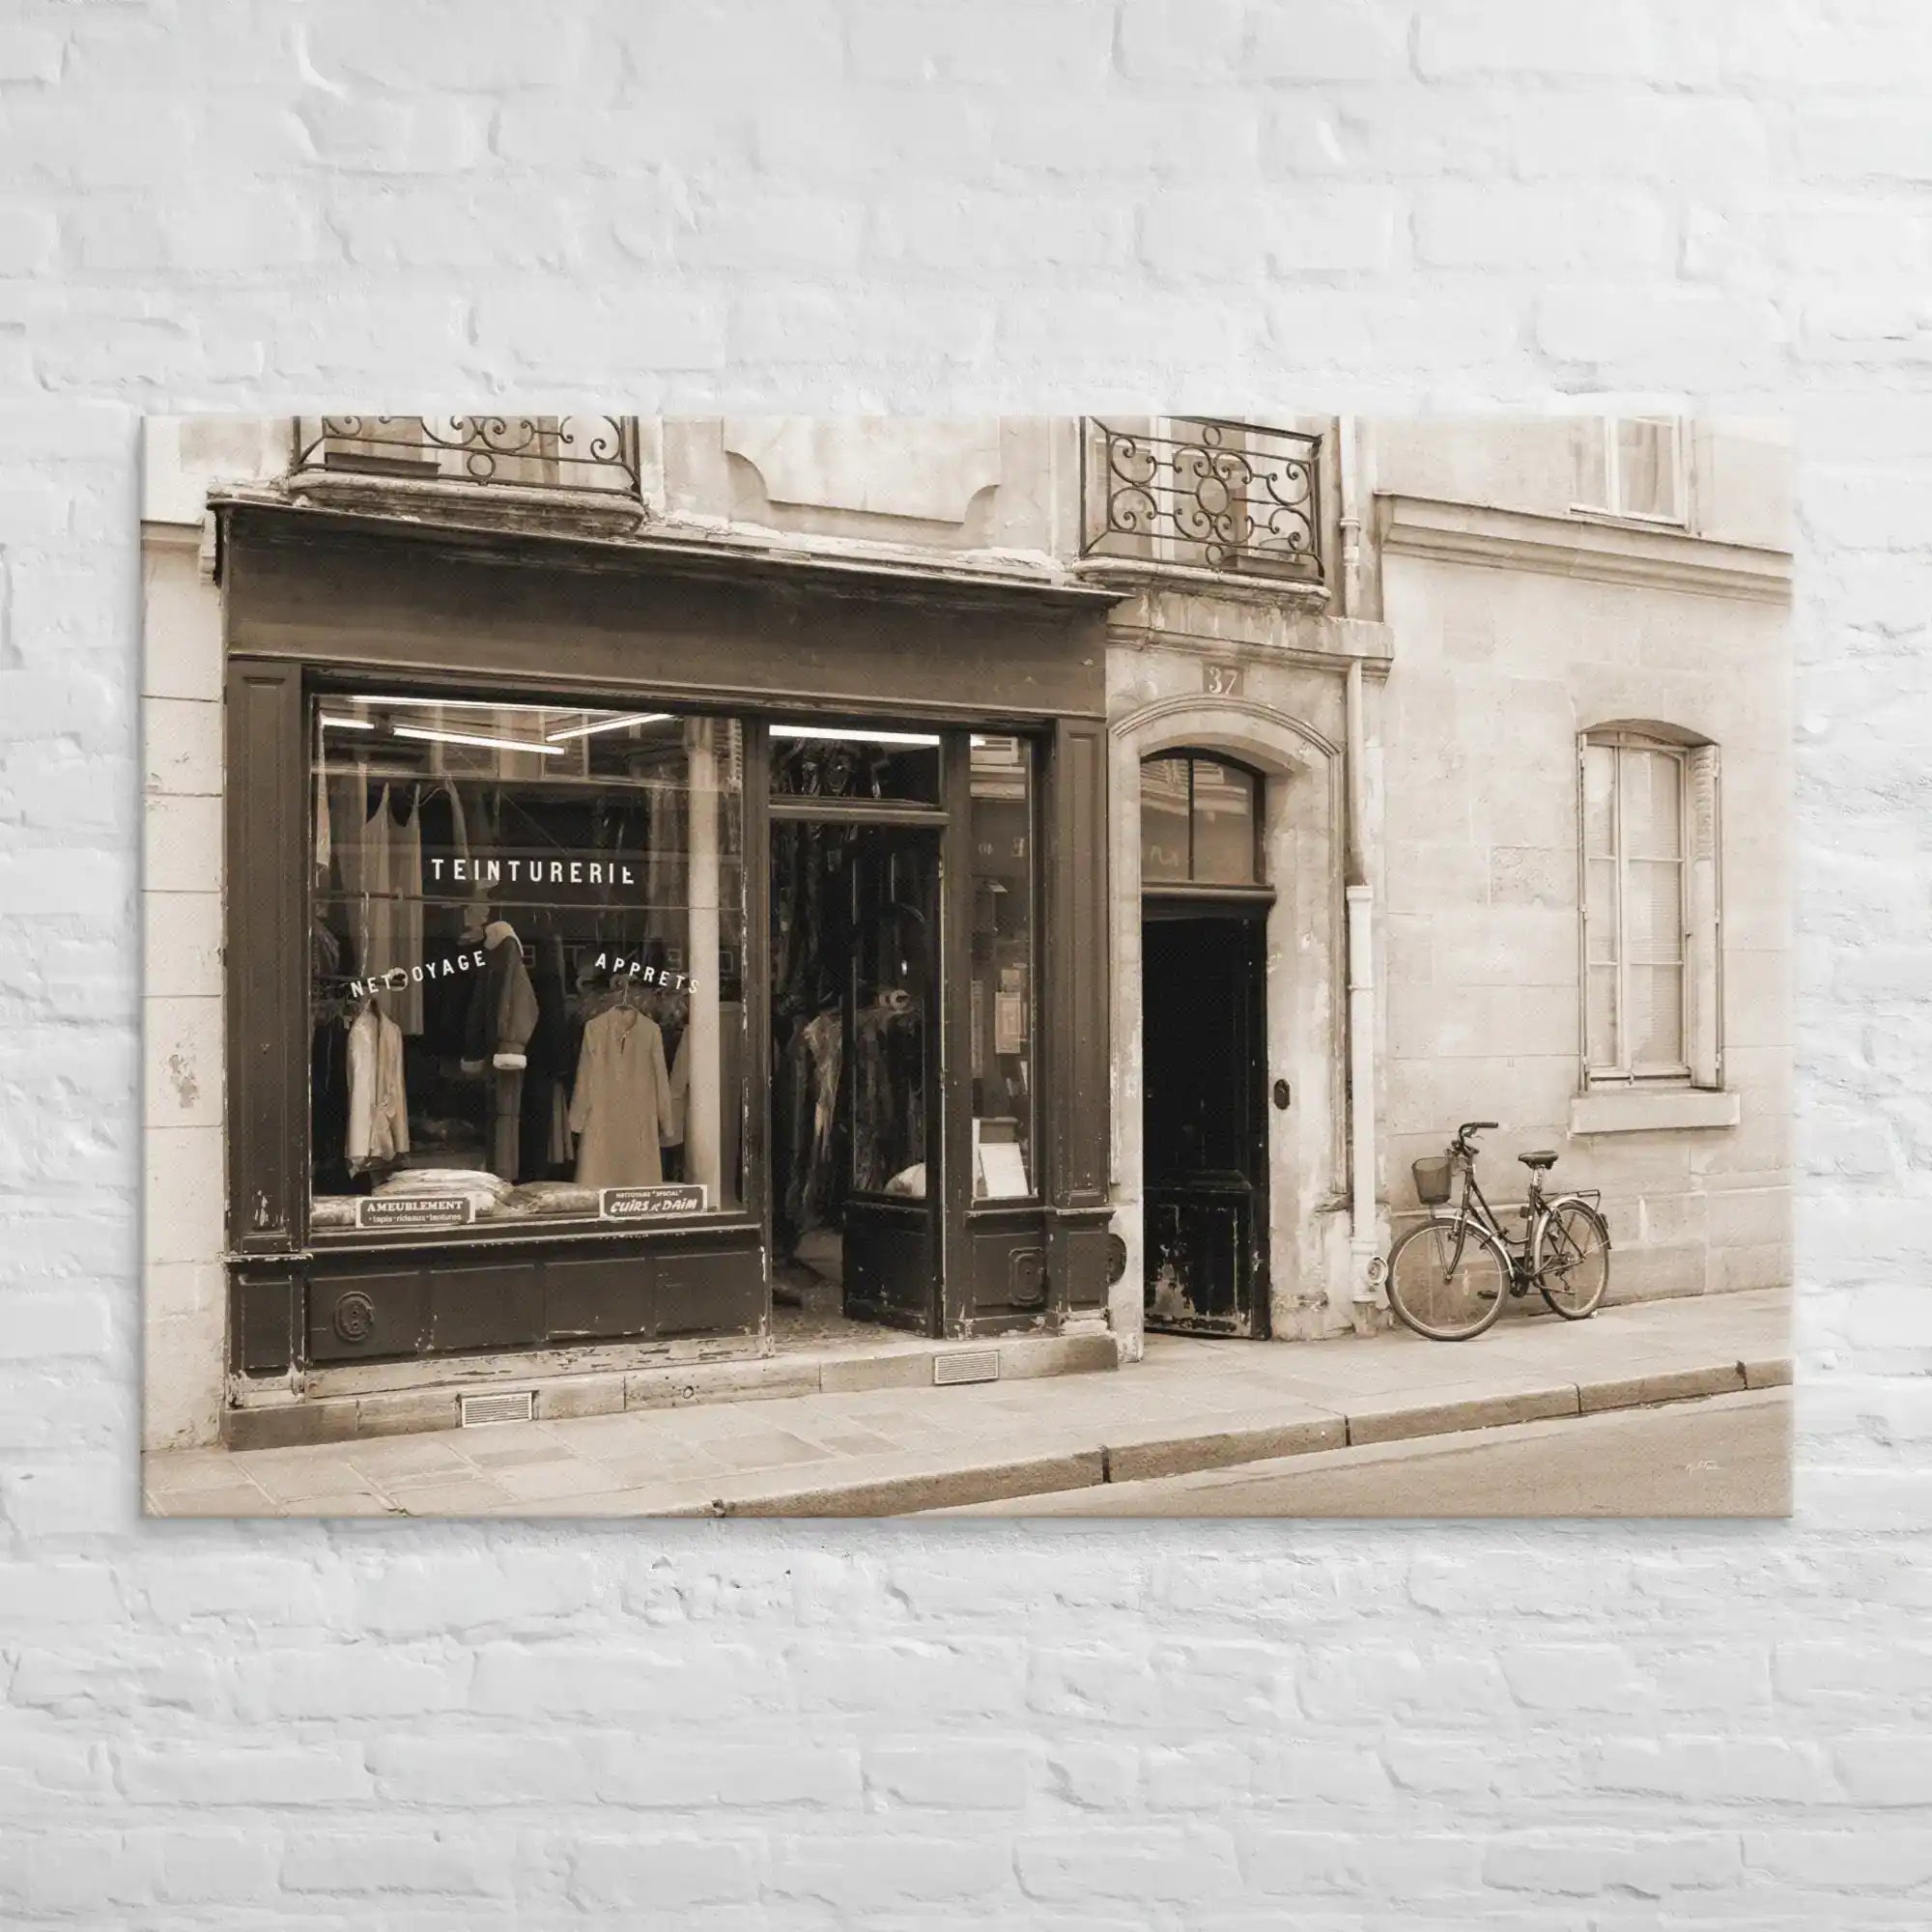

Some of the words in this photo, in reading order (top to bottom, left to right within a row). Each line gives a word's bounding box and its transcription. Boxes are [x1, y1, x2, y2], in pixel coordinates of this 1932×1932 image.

[1208, 666, 1238, 695] 37
[431, 858, 635, 885] TEINTURERIE
[350, 950, 487, 998] NETOYAGE
[594, 952, 699, 994] APPRETS
[367, 1201, 464, 1212] AMEUBLEMENT
